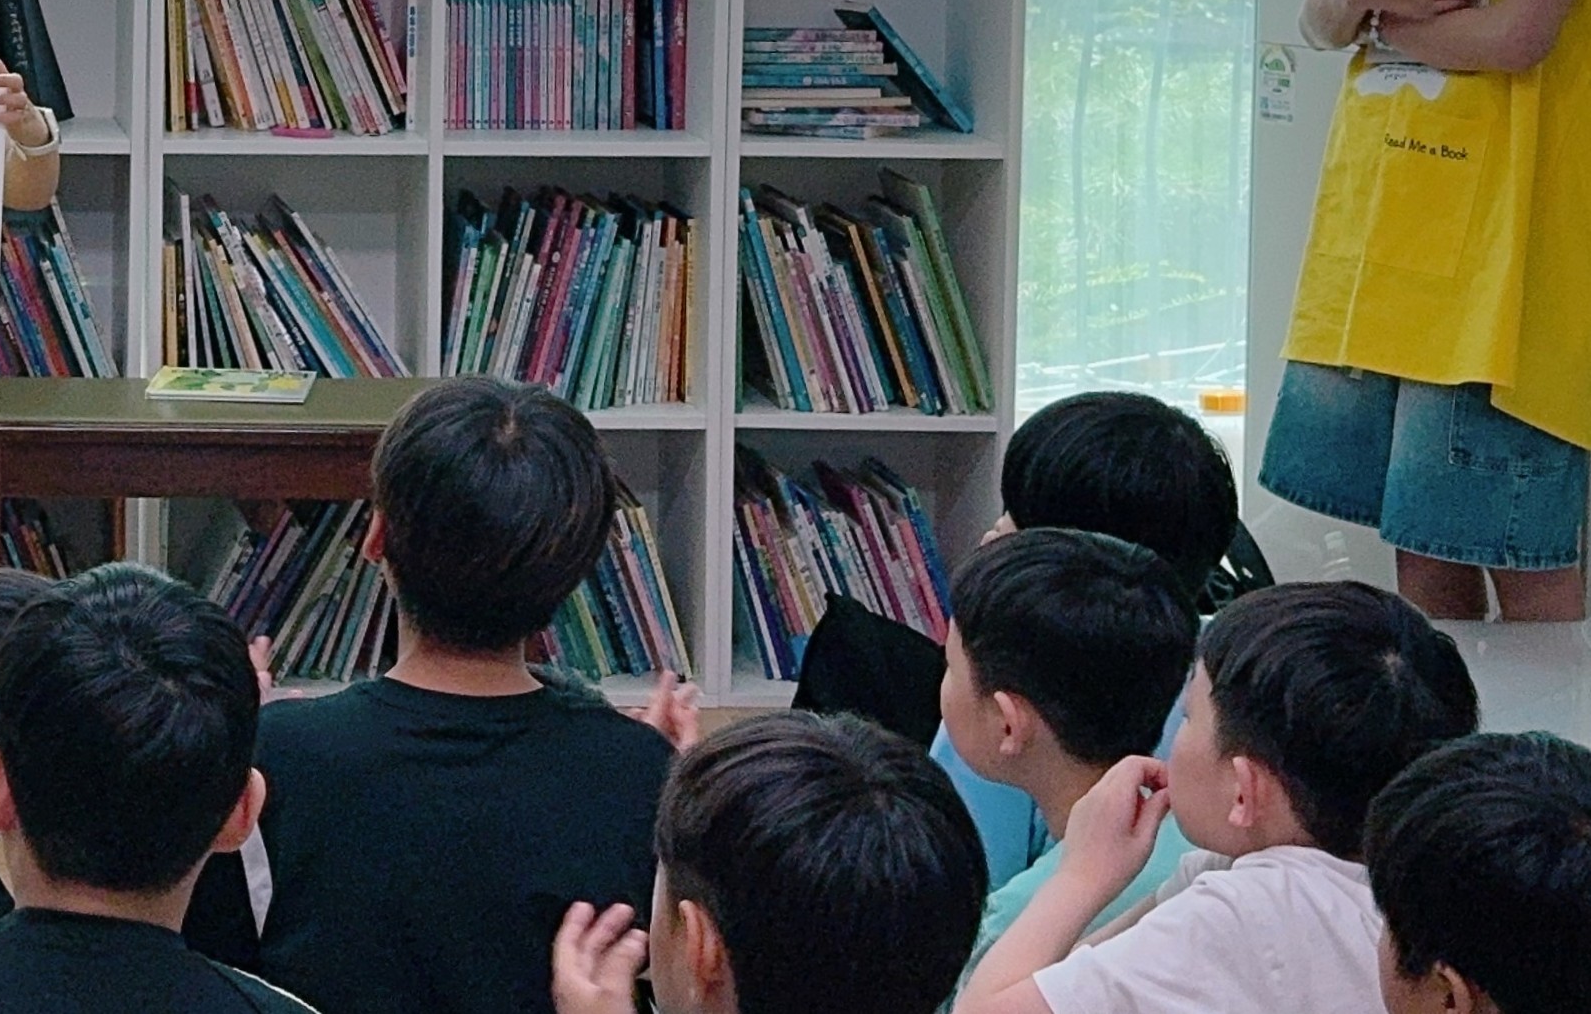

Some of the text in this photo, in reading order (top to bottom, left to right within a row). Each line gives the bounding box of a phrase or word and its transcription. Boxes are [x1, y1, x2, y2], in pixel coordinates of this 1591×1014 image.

[1408, 138, 1427, 153] Me
[1429, 147, 1436, 155] a
[1441, 144, 1470, 161] Book
